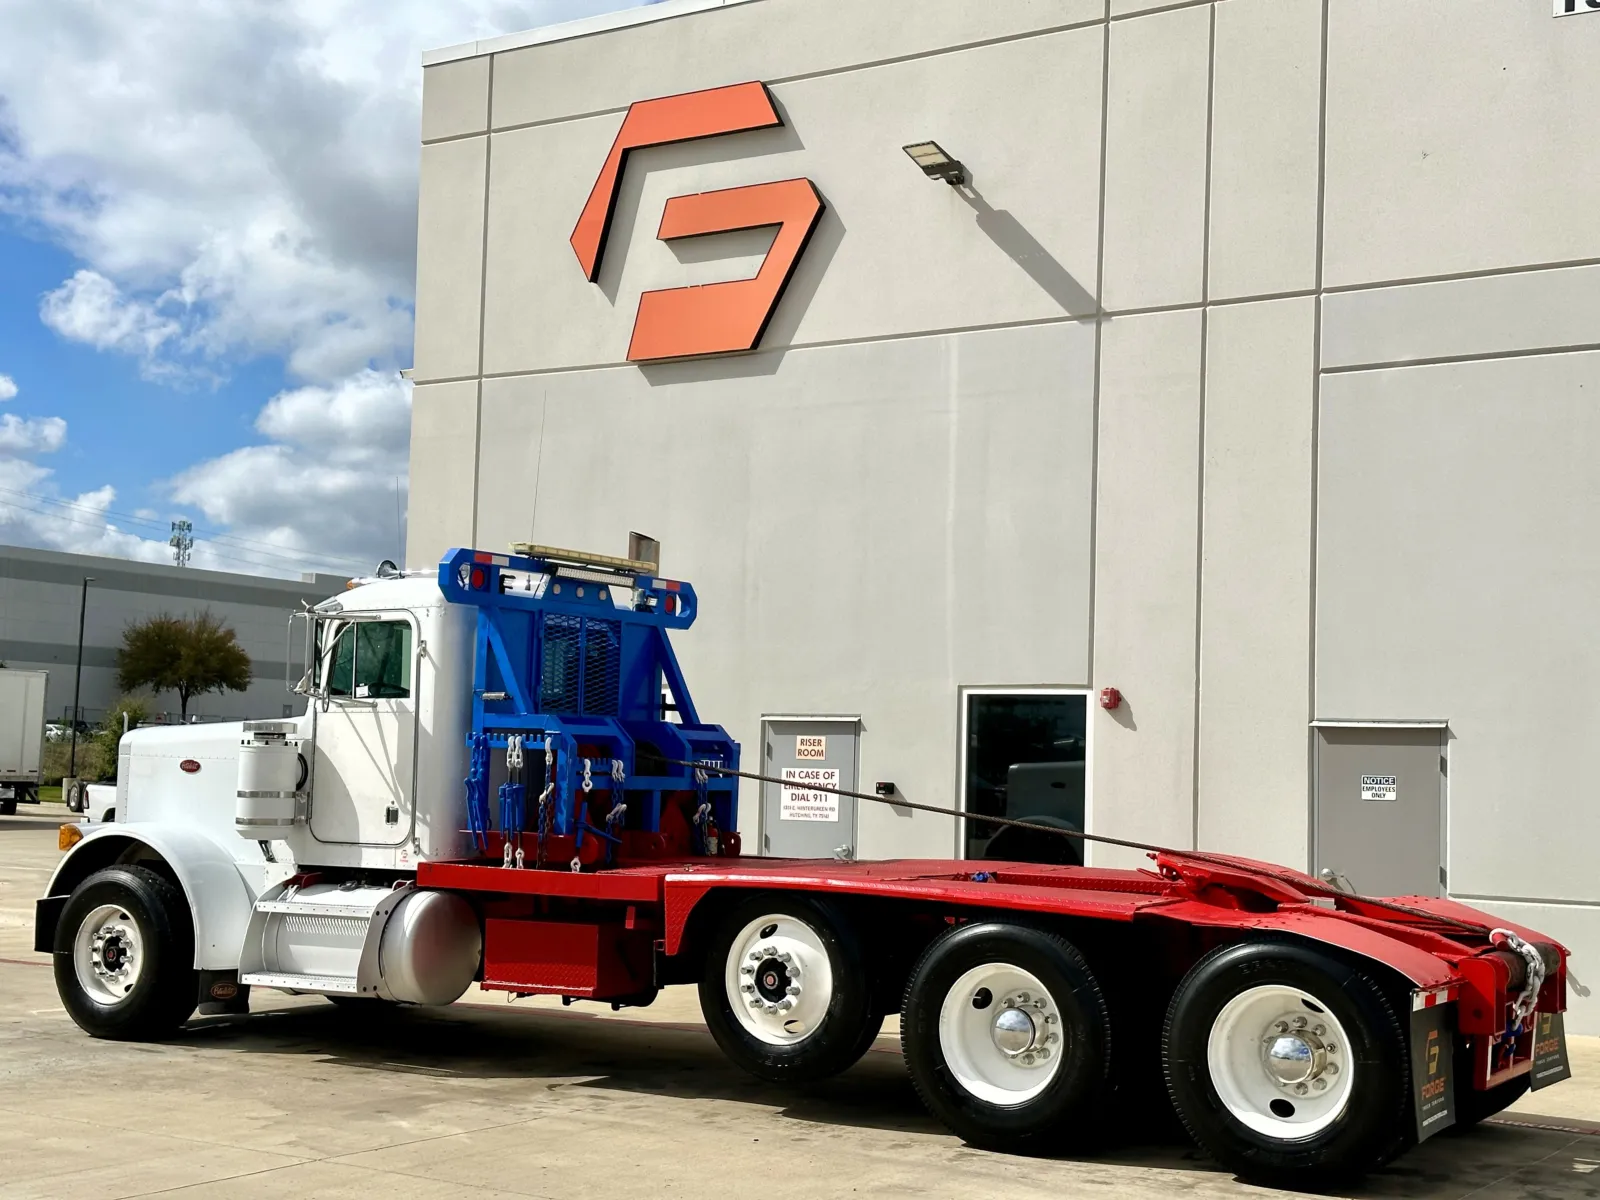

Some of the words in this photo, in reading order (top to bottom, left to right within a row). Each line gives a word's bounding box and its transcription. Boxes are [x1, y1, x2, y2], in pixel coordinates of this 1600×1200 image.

[800, 738, 822, 746] RISER
[797, 749, 824, 757] ROOM
[786, 770, 796, 779] IN
[798, 770, 820, 779] CASE
[823, 771, 835, 779] OF
[1363, 777, 1394, 785] NOTICE
[790, 793, 810, 802] DIAL
[813, 793, 828, 802] 911
[1536, 1038, 1560, 1056] FORGE
[1421, 1077, 1446, 1100] FORGE
